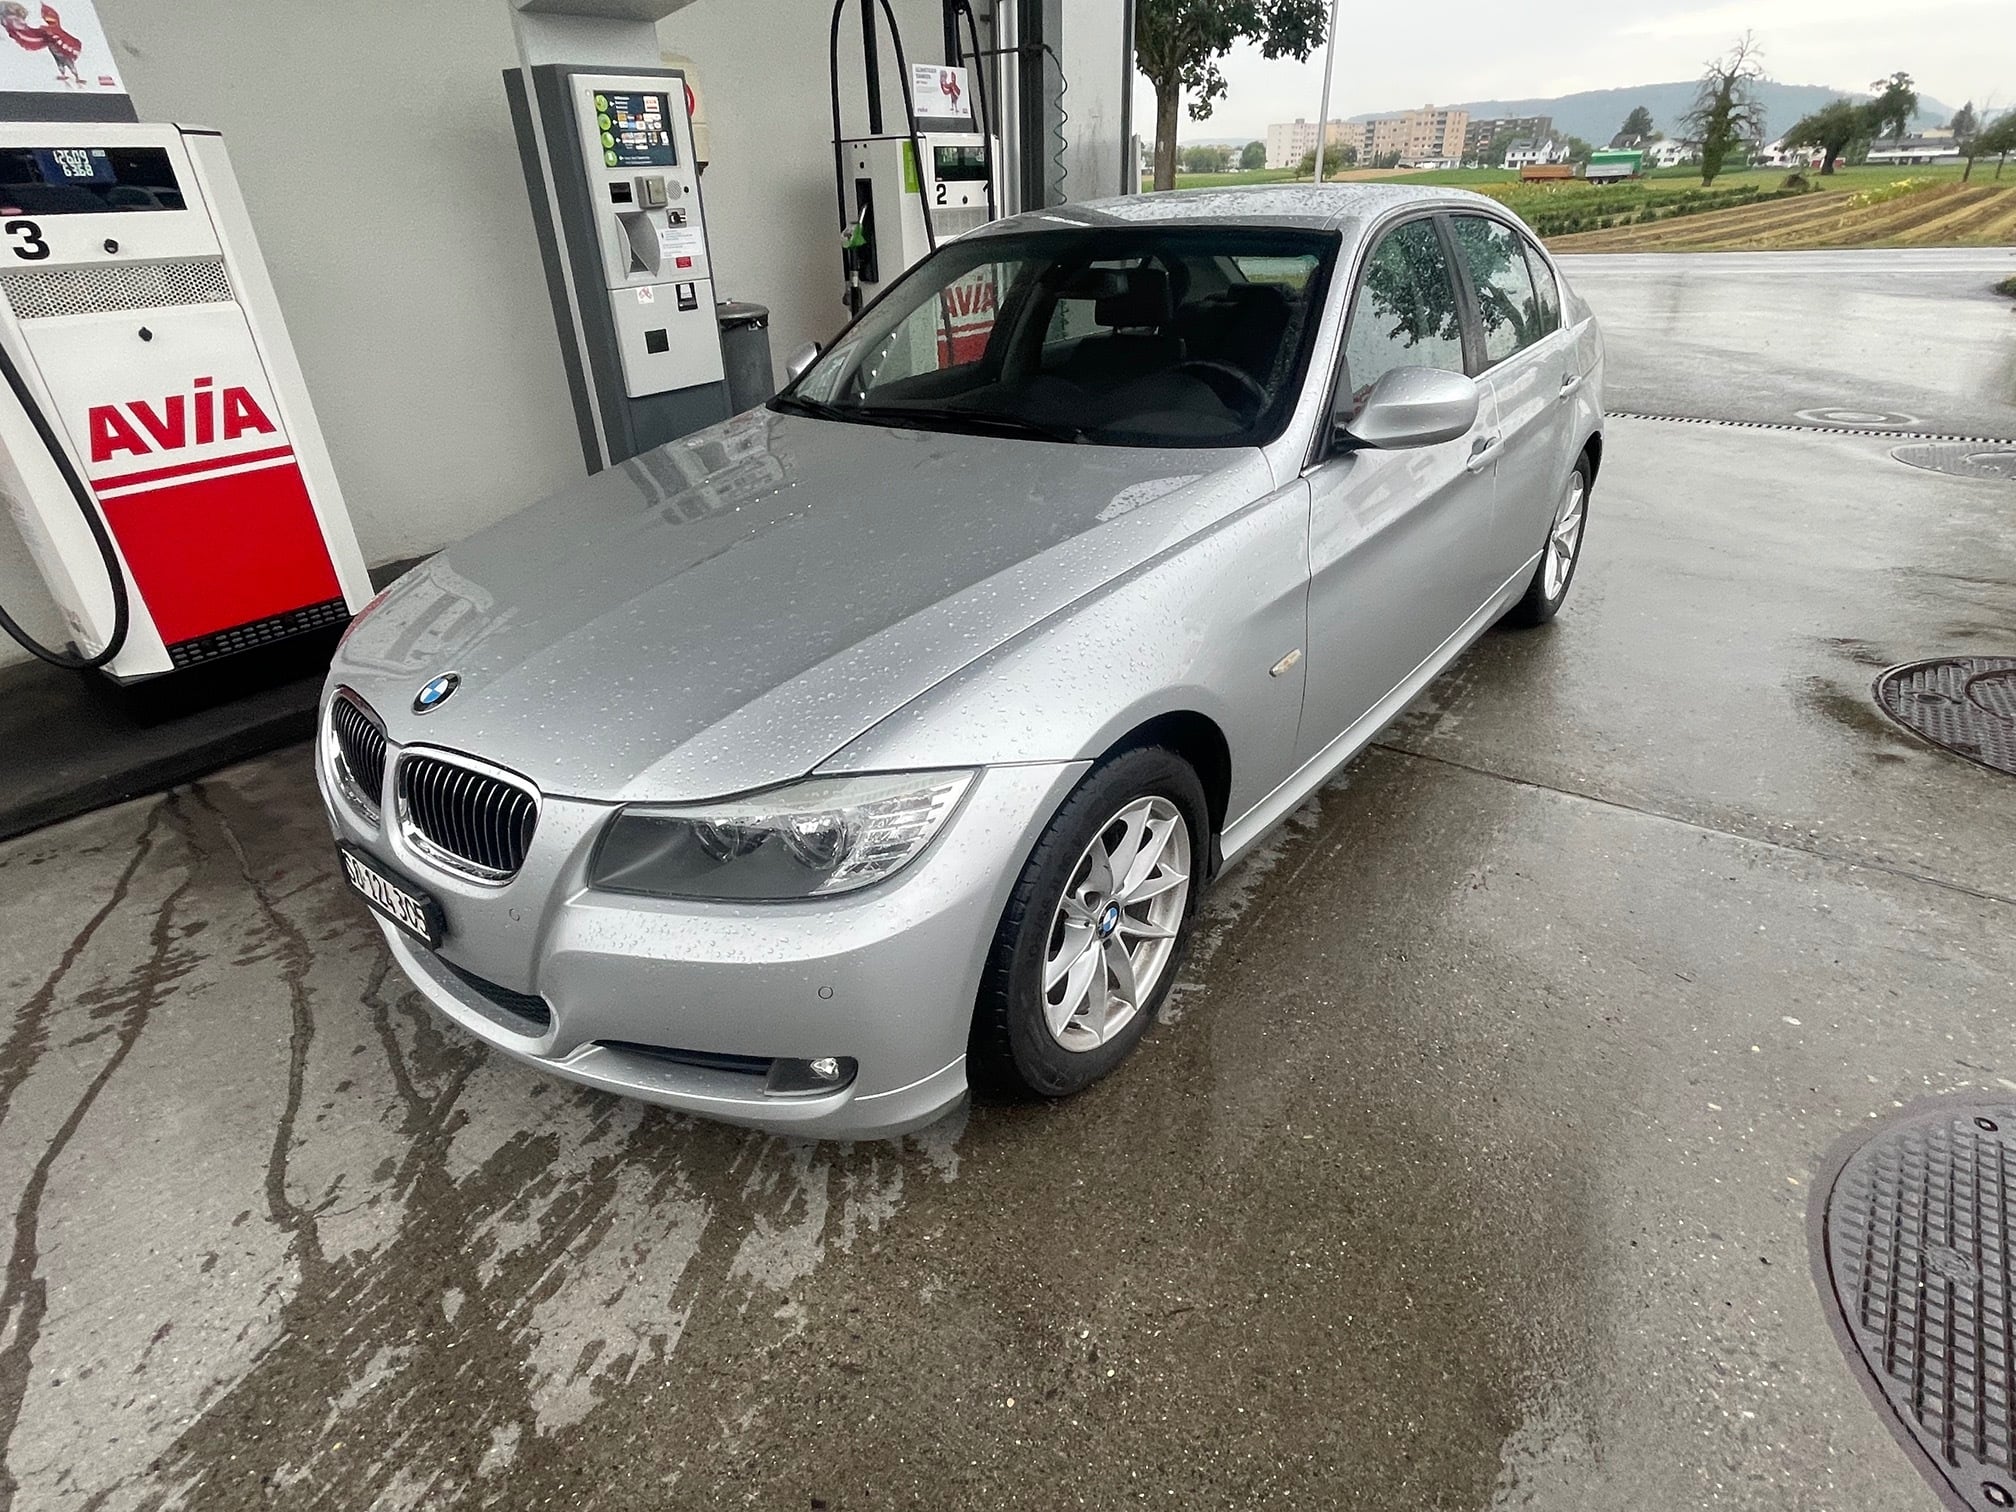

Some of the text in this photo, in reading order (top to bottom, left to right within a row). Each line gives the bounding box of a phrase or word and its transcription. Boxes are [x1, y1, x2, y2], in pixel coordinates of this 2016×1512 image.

[936, 184, 947, 205] 2
[5, 220, 50, 260] 3
[89, 376, 277, 463] AVIA
